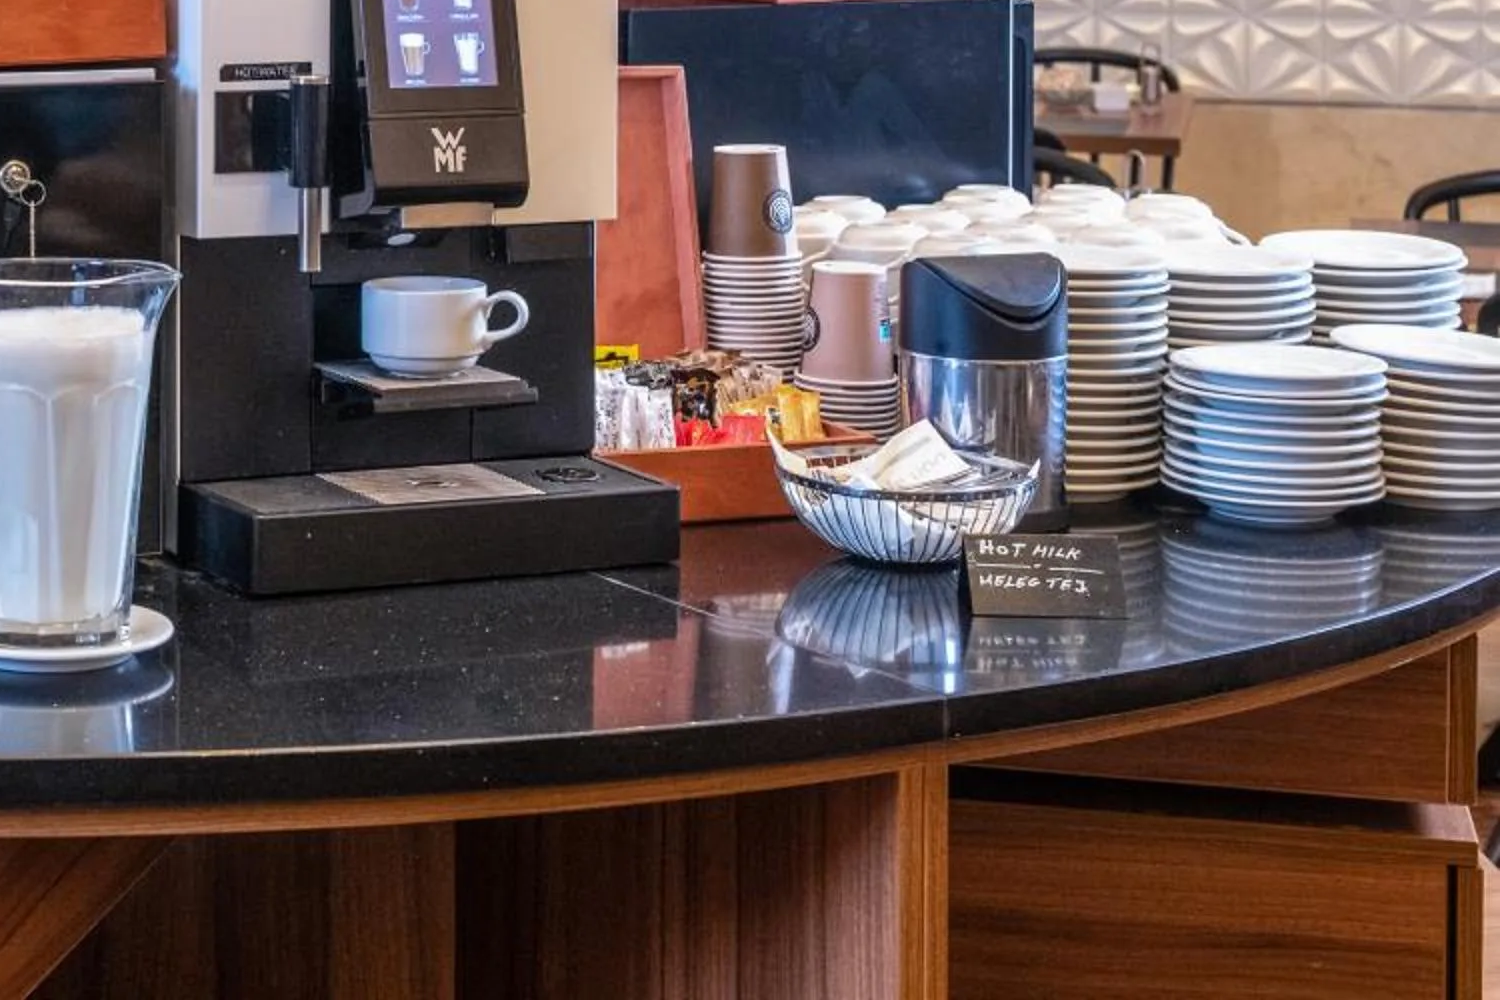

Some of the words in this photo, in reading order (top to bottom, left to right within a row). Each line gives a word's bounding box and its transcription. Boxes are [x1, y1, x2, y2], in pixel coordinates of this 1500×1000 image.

[979, 540, 1027, 558] HOT
[1032, 543, 1082, 561] MILK
[979, 574, 1041, 589] MELEG
